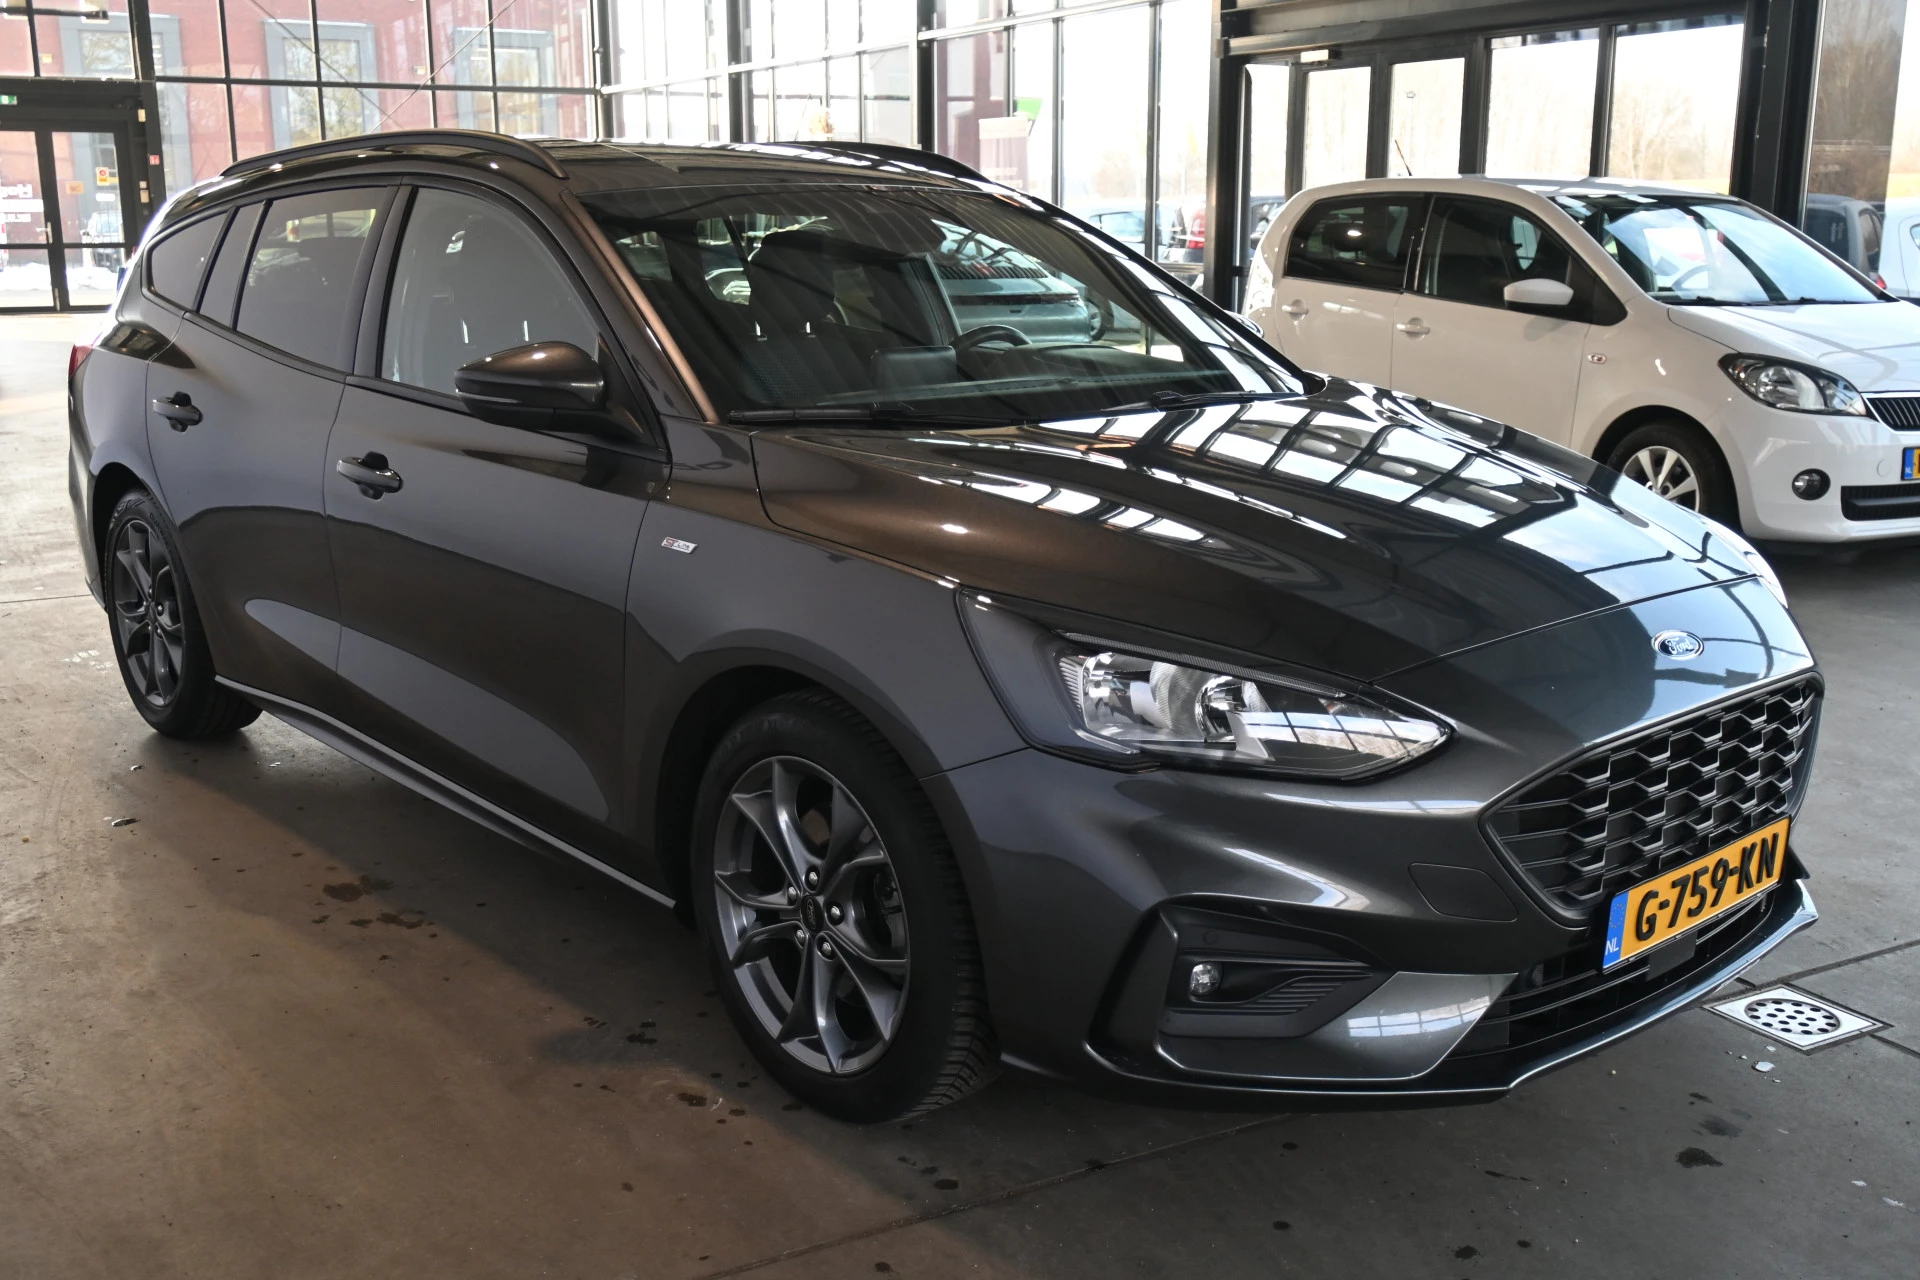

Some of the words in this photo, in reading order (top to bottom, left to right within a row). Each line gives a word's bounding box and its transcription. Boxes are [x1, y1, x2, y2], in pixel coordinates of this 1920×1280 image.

[1665, 637, 1695, 655] Ford
[1635, 832, 1779, 941] G-759-KN
[1605, 937, 1619, 955] NL
